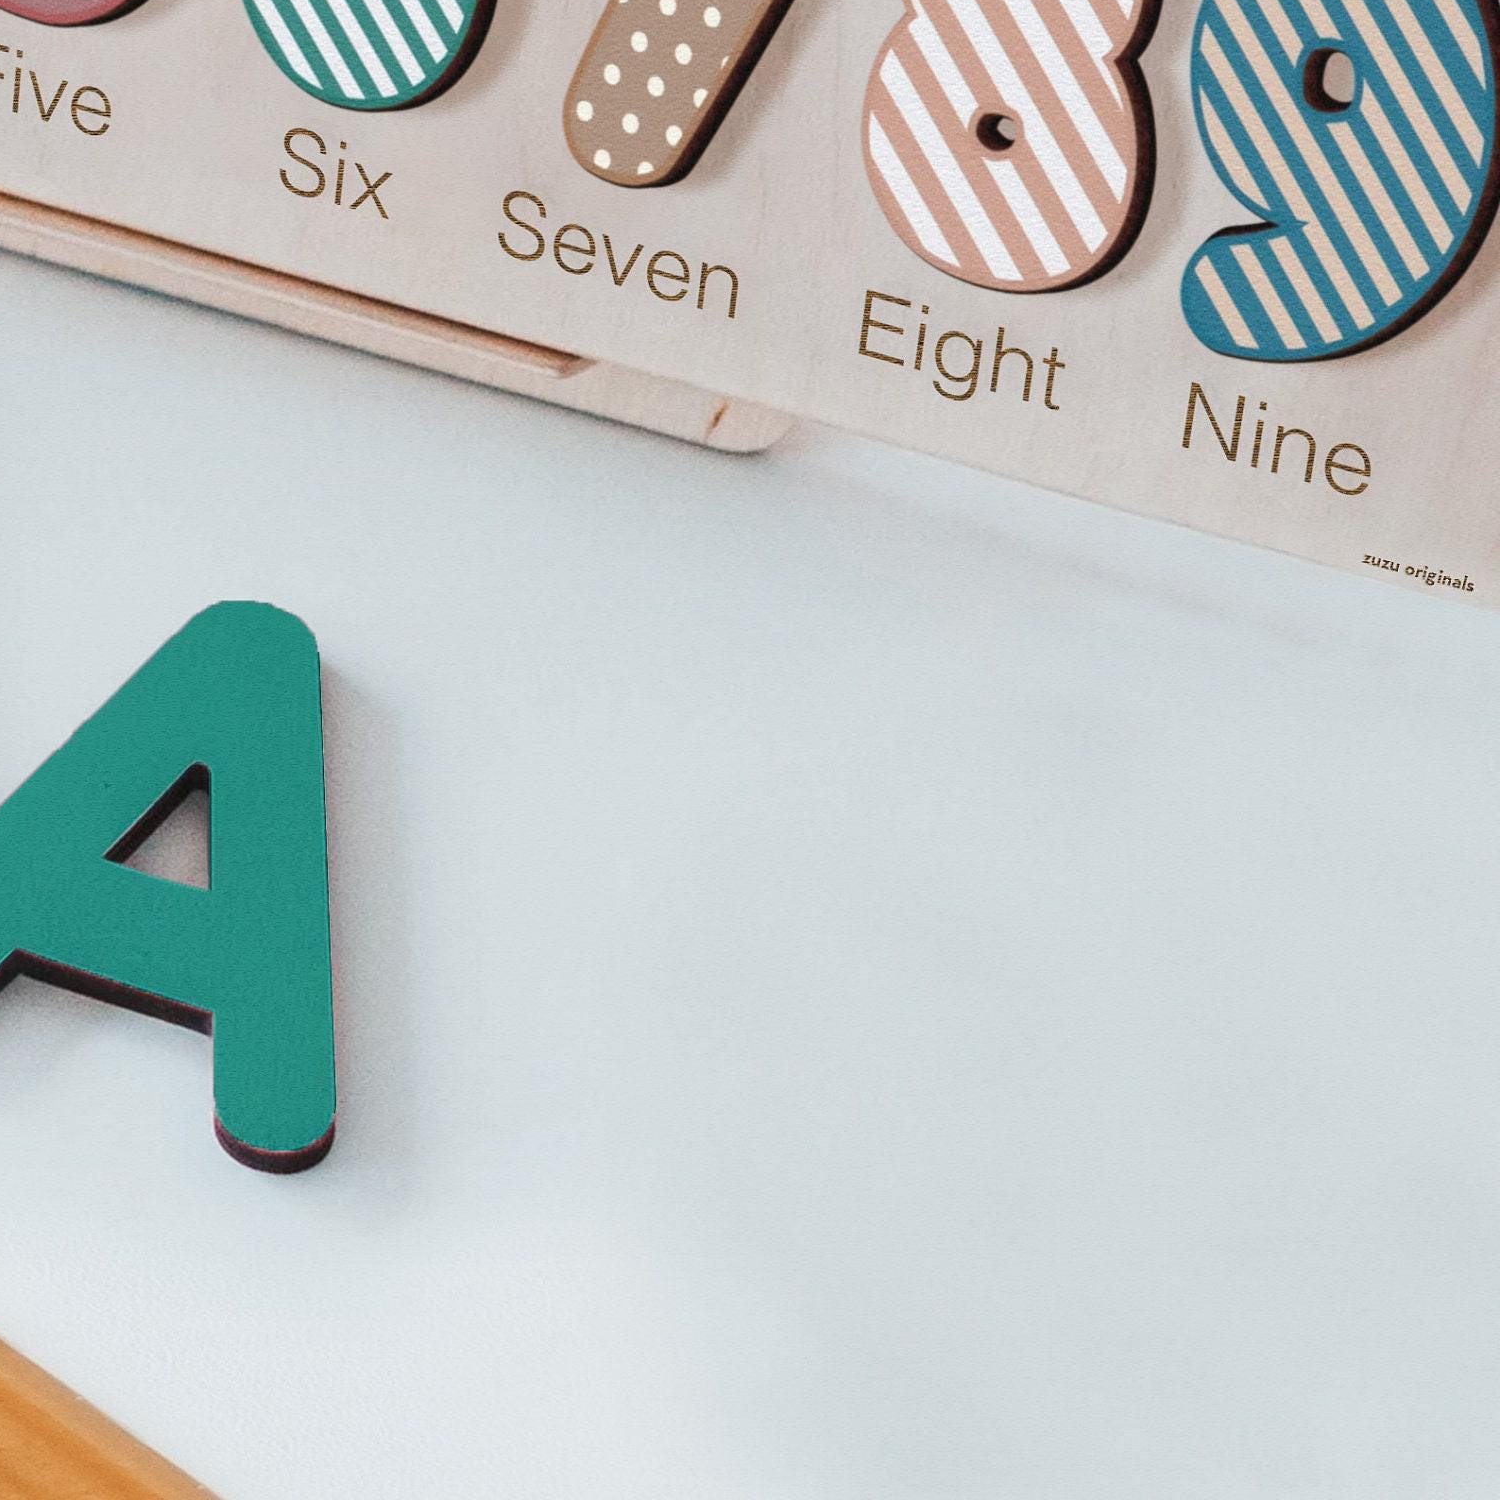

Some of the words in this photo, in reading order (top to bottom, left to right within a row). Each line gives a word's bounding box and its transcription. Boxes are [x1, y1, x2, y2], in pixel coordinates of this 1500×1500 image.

[279, 127, 393, 220] Six
[497, 191, 739, 319] Seven
[858, 289, 1067, 411] Eight
[1181, 381, 1372, 496] Nine
[1361, 553, 1401, 573] zuzu
[1404, 565, 1475, 593] originals
